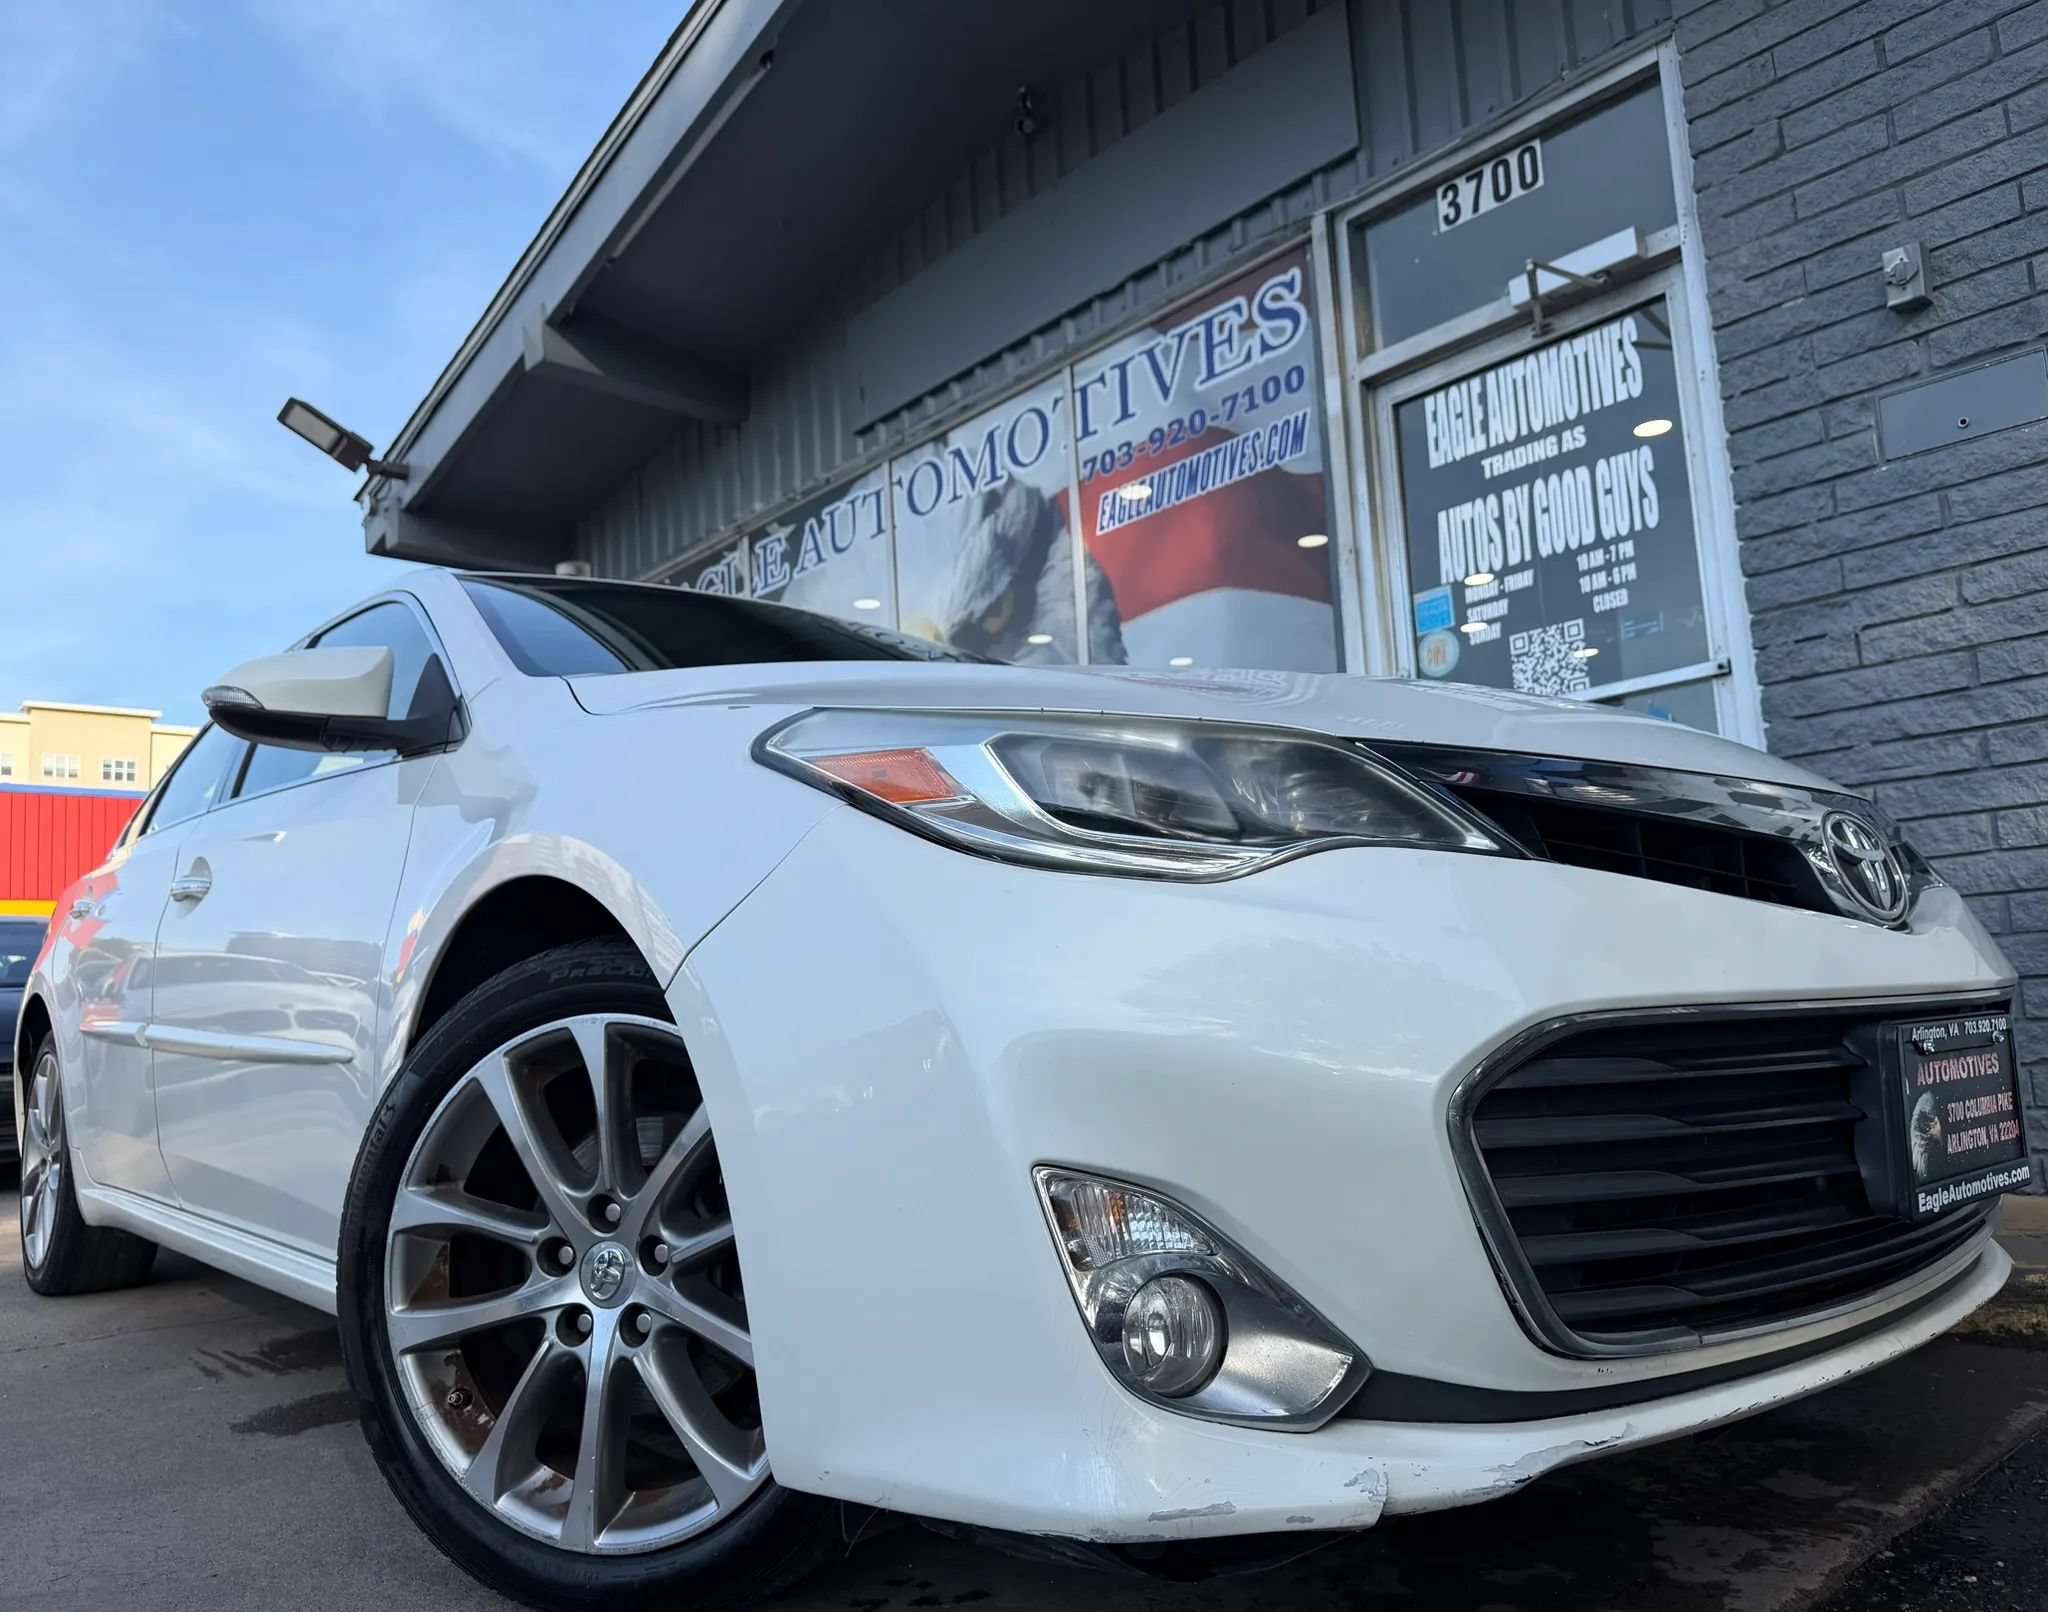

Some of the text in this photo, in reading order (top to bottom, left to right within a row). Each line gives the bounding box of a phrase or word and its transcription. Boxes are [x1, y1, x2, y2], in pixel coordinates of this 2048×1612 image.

[1441, 145, 1539, 227] 3700
[1424, 318, 1644, 470] EAGLE AUTOMOTIVES
[697, 267, 1307, 600] GLE AUTOMOTIVES
[1083, 365, 1306, 483] 703-920-7100
[1481, 424, 1588, 480] TRADING AS
[1097, 408, 1311, 535] EAGLEAUTOMOTIVES.COM
[1437, 445, 1660, 585] AUTOS BY GOOD GUYS
[1618, 540, 1635, 560] PM
[1465, 579, 1499, 605] MONDAY
[1504, 568, 1534, 593] FRIDAY
[1621, 562, 1637, 583] PM
[1467, 598, 1509, 623] SATURDAY
[1592, 588, 1630, 613] CLOSED
[1468, 621, 1501, 646] SUNDAY
[1912, 1018, 2007, 1042] Arlington, VA 703.920.7100
[1917, 1053, 2000, 1086] AUTOMOTIVES
[1947, 1091, 2013, 1123] 3700 COLUMBIA PIKE
[1989, 1124, 2000, 1144] VA
[1918, 1166, 2030, 1213] EagleAutomotives.com
